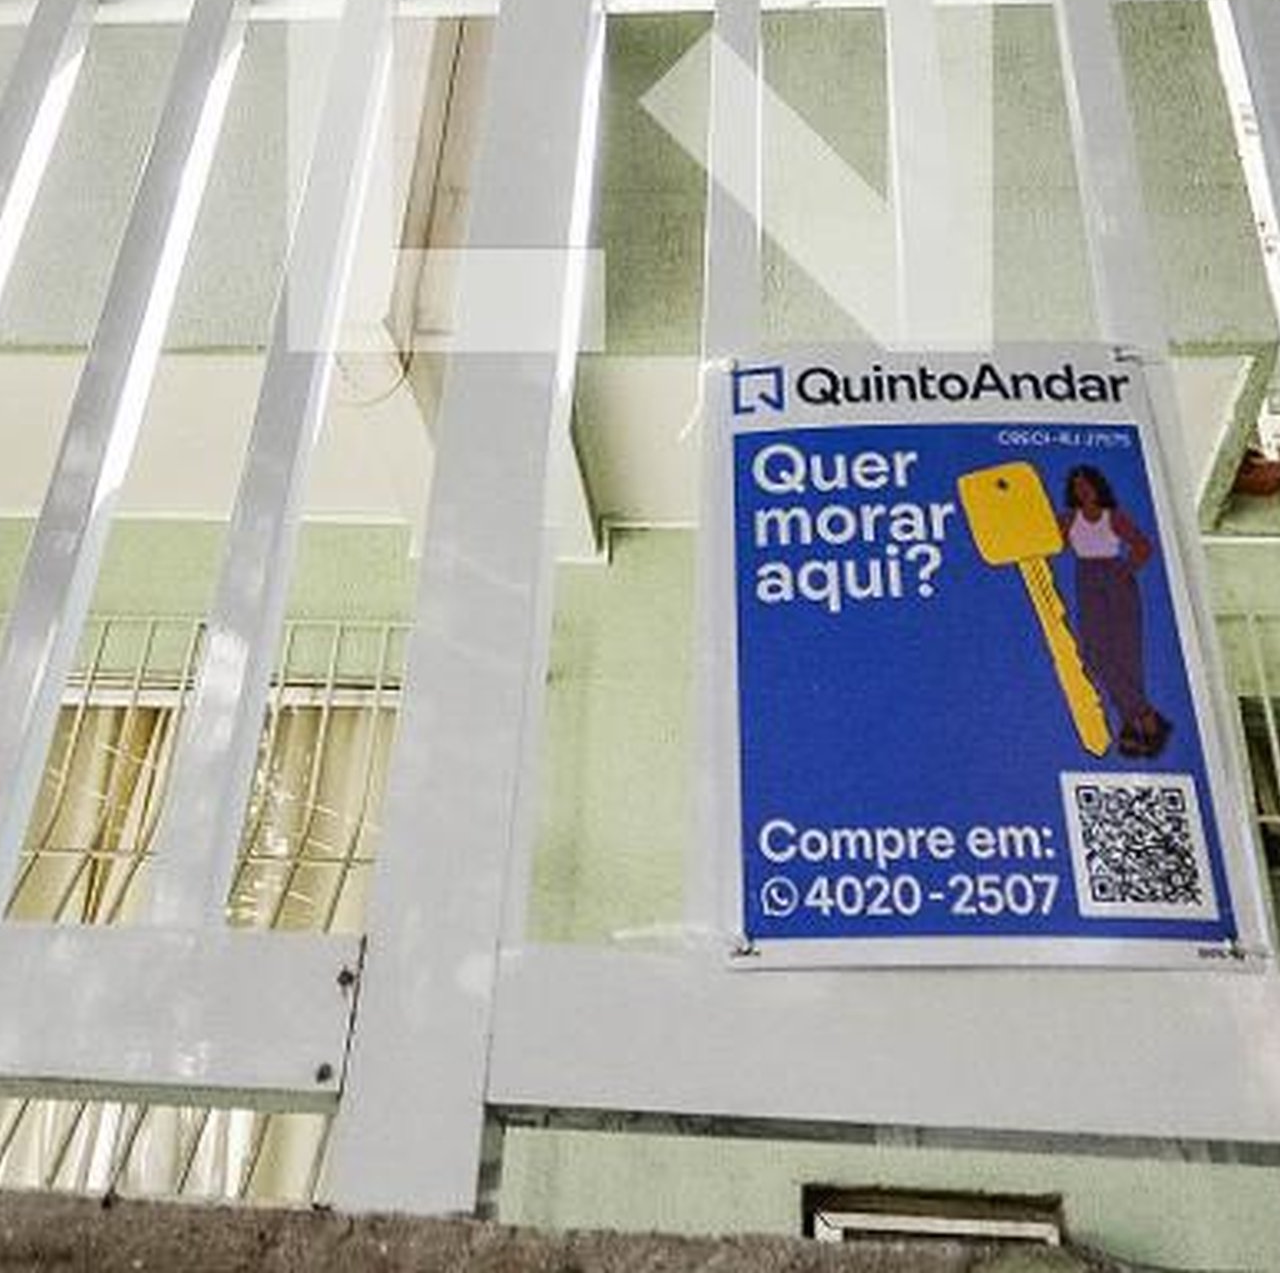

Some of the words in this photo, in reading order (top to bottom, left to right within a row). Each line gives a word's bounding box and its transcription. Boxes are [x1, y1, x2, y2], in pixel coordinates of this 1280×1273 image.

[795, 363, 1131, 406] QuintoAndar
[751, 442, 918, 494] Quer
[755, 502, 956, 548] morar
[755, 543, 942, 613] aqui?
[759, 819, 956, 870] Compre
[966, 825, 1056, 859] em:
